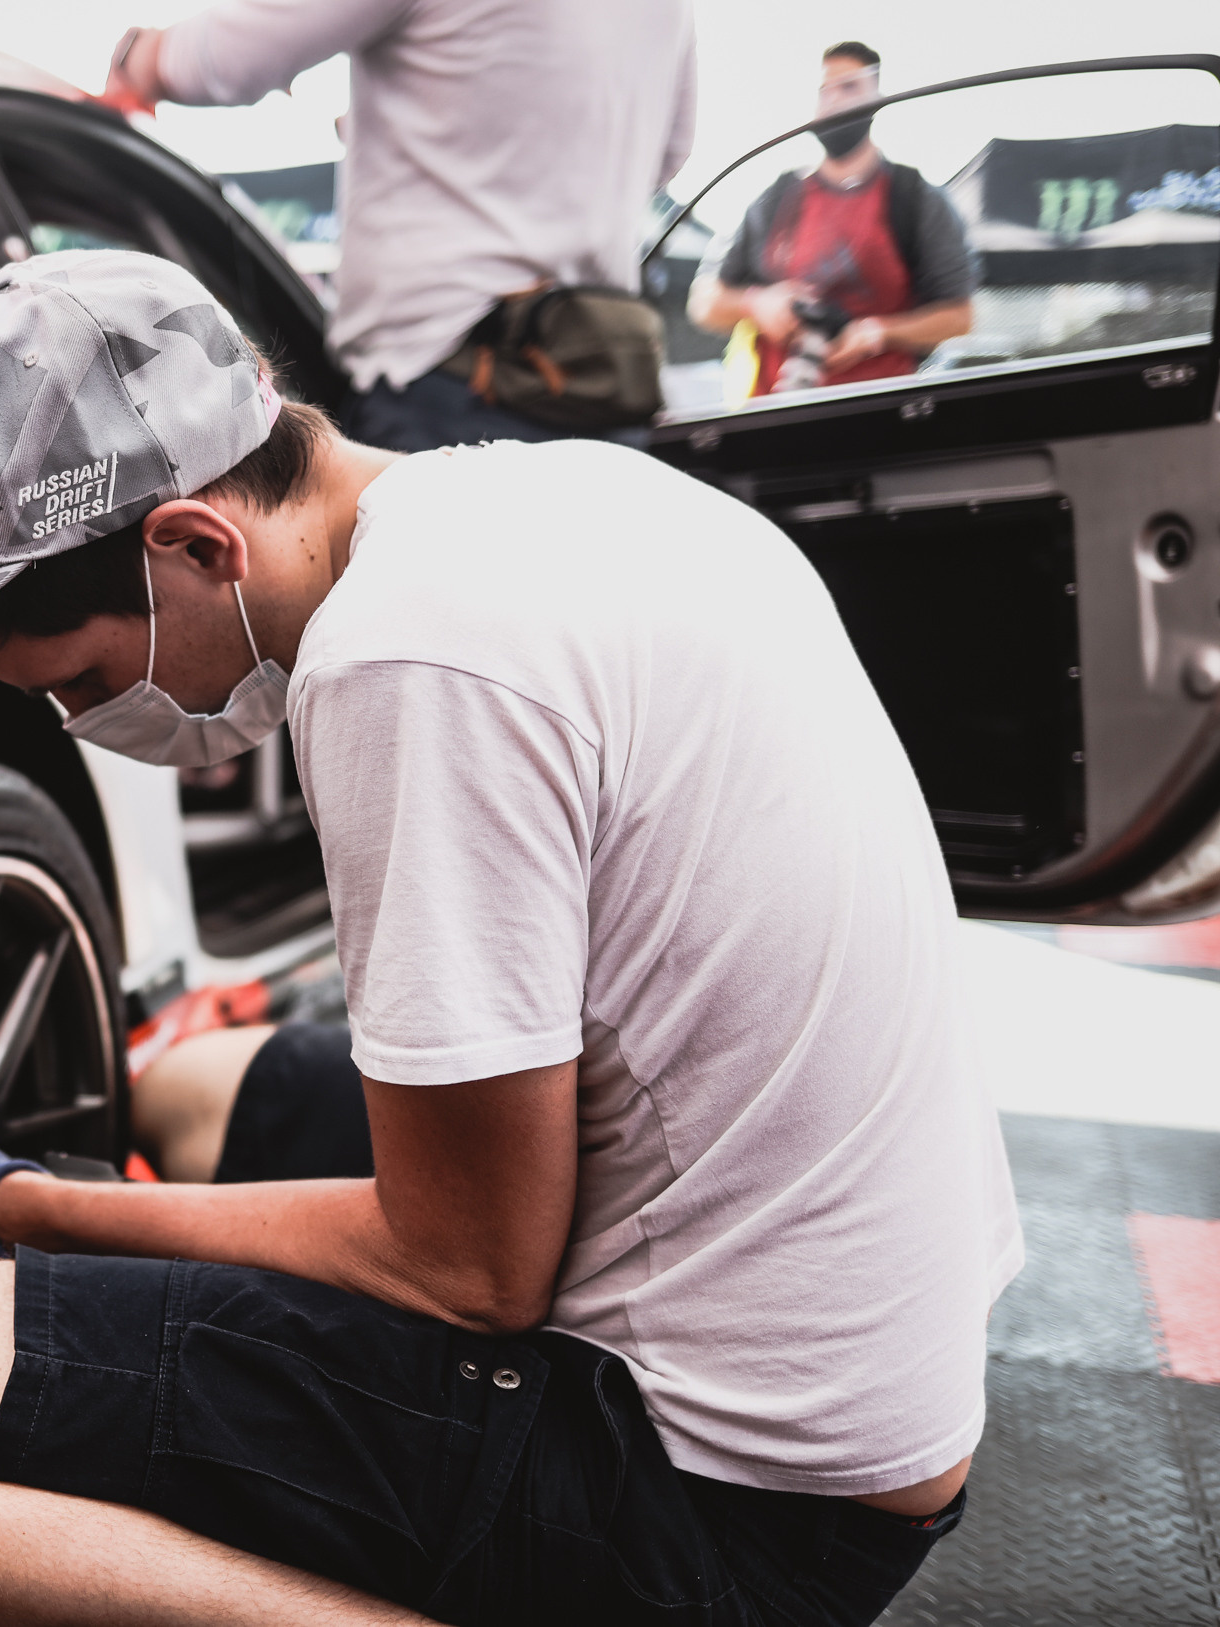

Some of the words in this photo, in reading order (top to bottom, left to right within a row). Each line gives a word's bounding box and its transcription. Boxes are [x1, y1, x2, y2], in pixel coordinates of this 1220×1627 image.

[17, 458, 109, 507] RUSSIAN
[44, 478, 107, 516] DRIFT
[32, 498, 105, 540] SERIES
